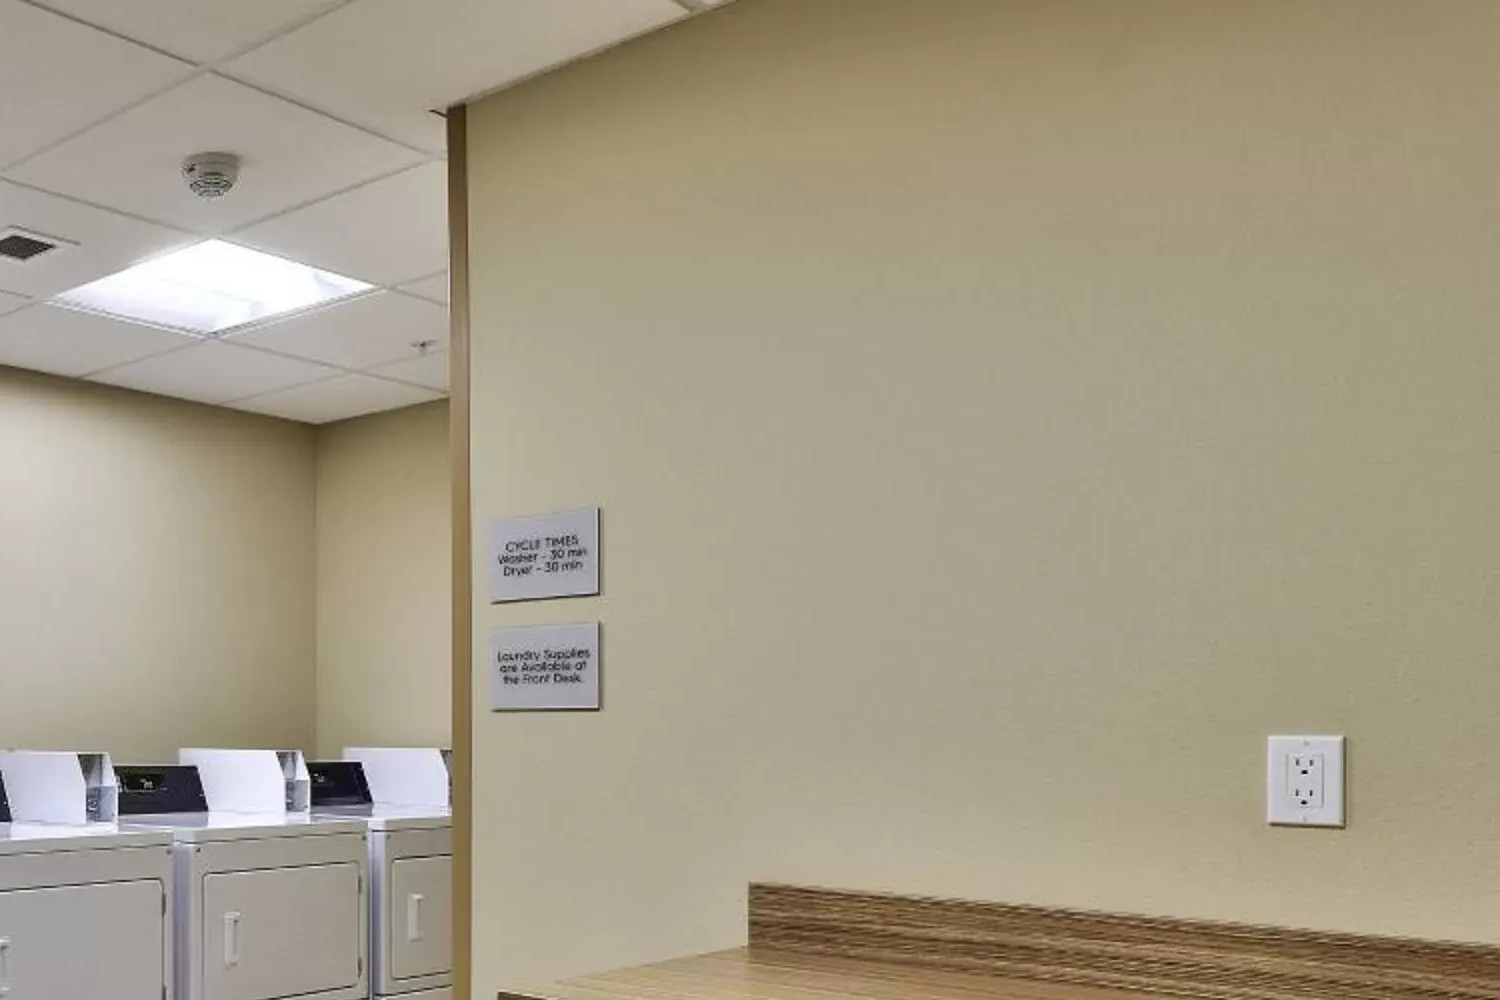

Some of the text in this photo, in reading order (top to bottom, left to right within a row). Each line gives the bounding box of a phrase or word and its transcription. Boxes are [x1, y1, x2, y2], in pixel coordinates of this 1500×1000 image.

[505, 534, 579, 552] CYCLE TIMES
[498, 553, 537, 565] Washer
[503, 565, 533, 577] Dryer
[561, 559, 583, 571] min
[497, 647, 590, 662] Laundry Supplies
[500, 660, 586, 673] are Available at
[523, 673, 550, 684] Front
